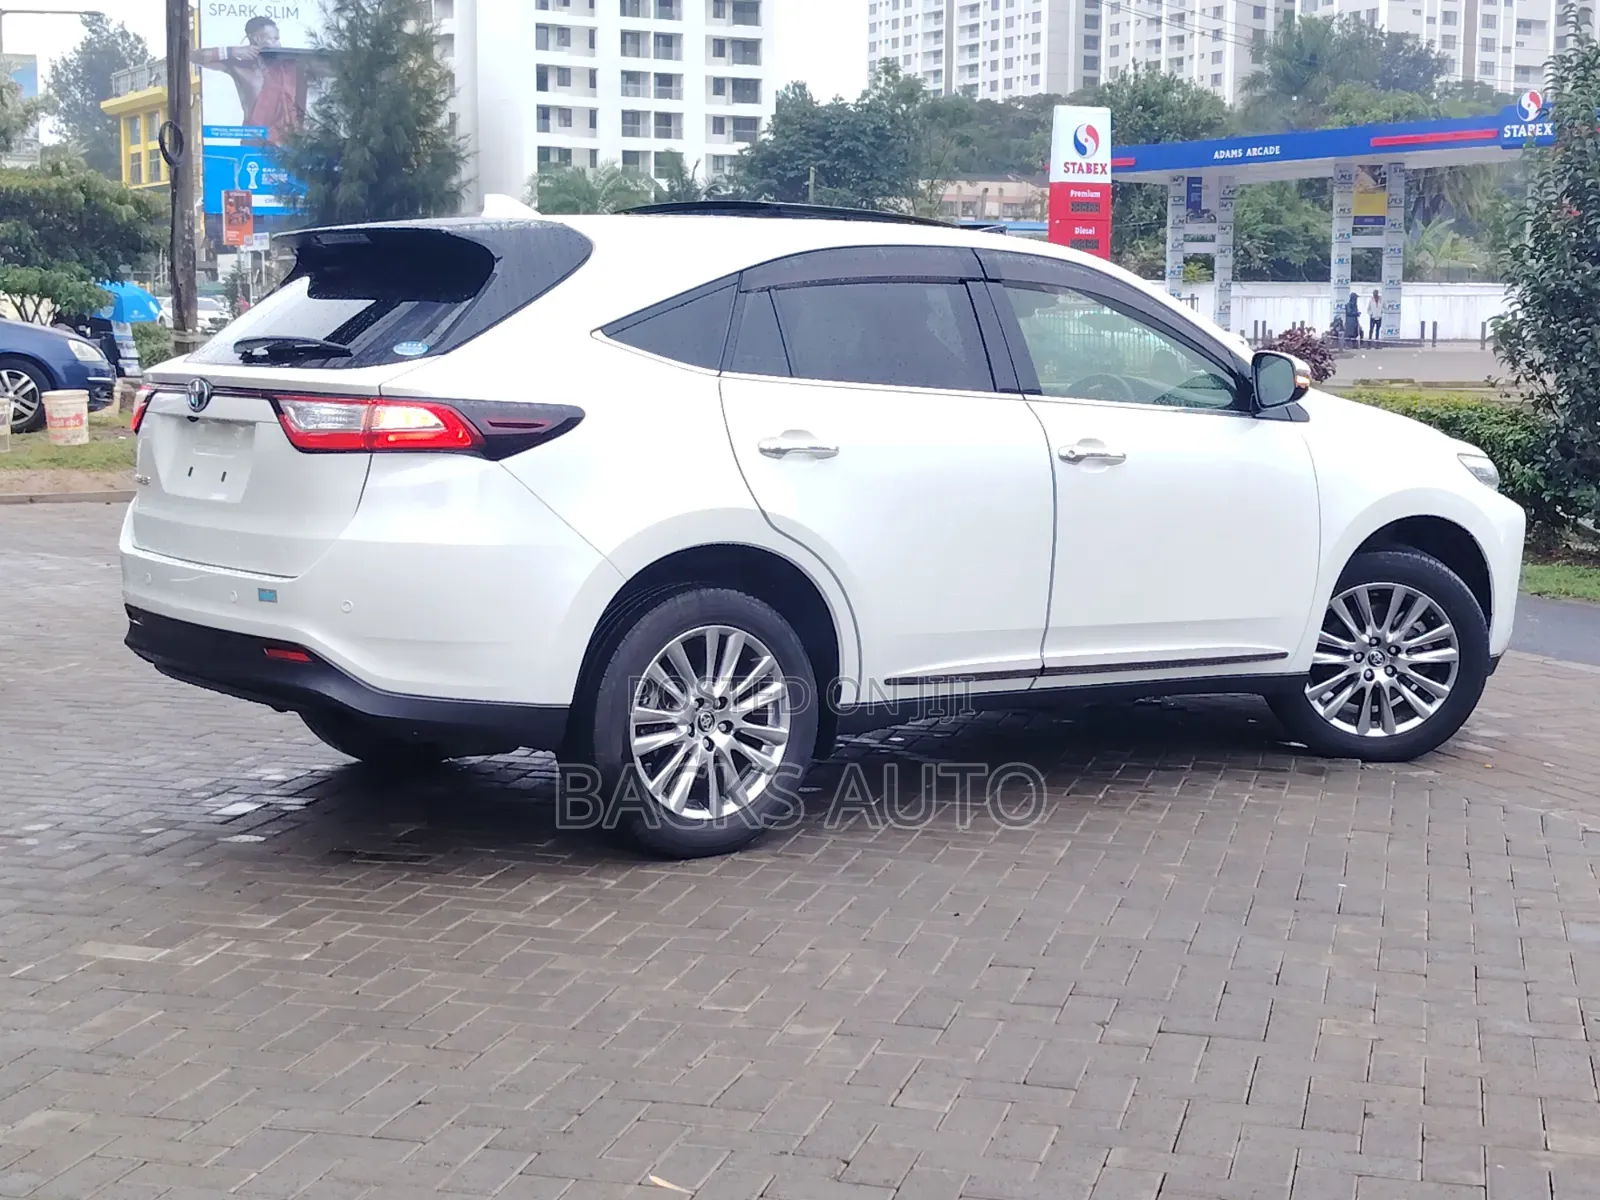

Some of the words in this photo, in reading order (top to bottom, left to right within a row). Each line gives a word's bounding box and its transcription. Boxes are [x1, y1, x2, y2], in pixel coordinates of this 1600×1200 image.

[209, 3, 258, 17] SPARK
[264, 5, 299, 19] SLIM
[1503, 122, 1554, 138] STABEX
[1213, 148, 1243, 160] ADAMS
[1246, 145, 1281, 157] ARCADE
[1063, 161, 1108, 175] STABEX
[1070, 189, 1101, 198] Premium
[1074, 226, 1096, 236] Diesel
